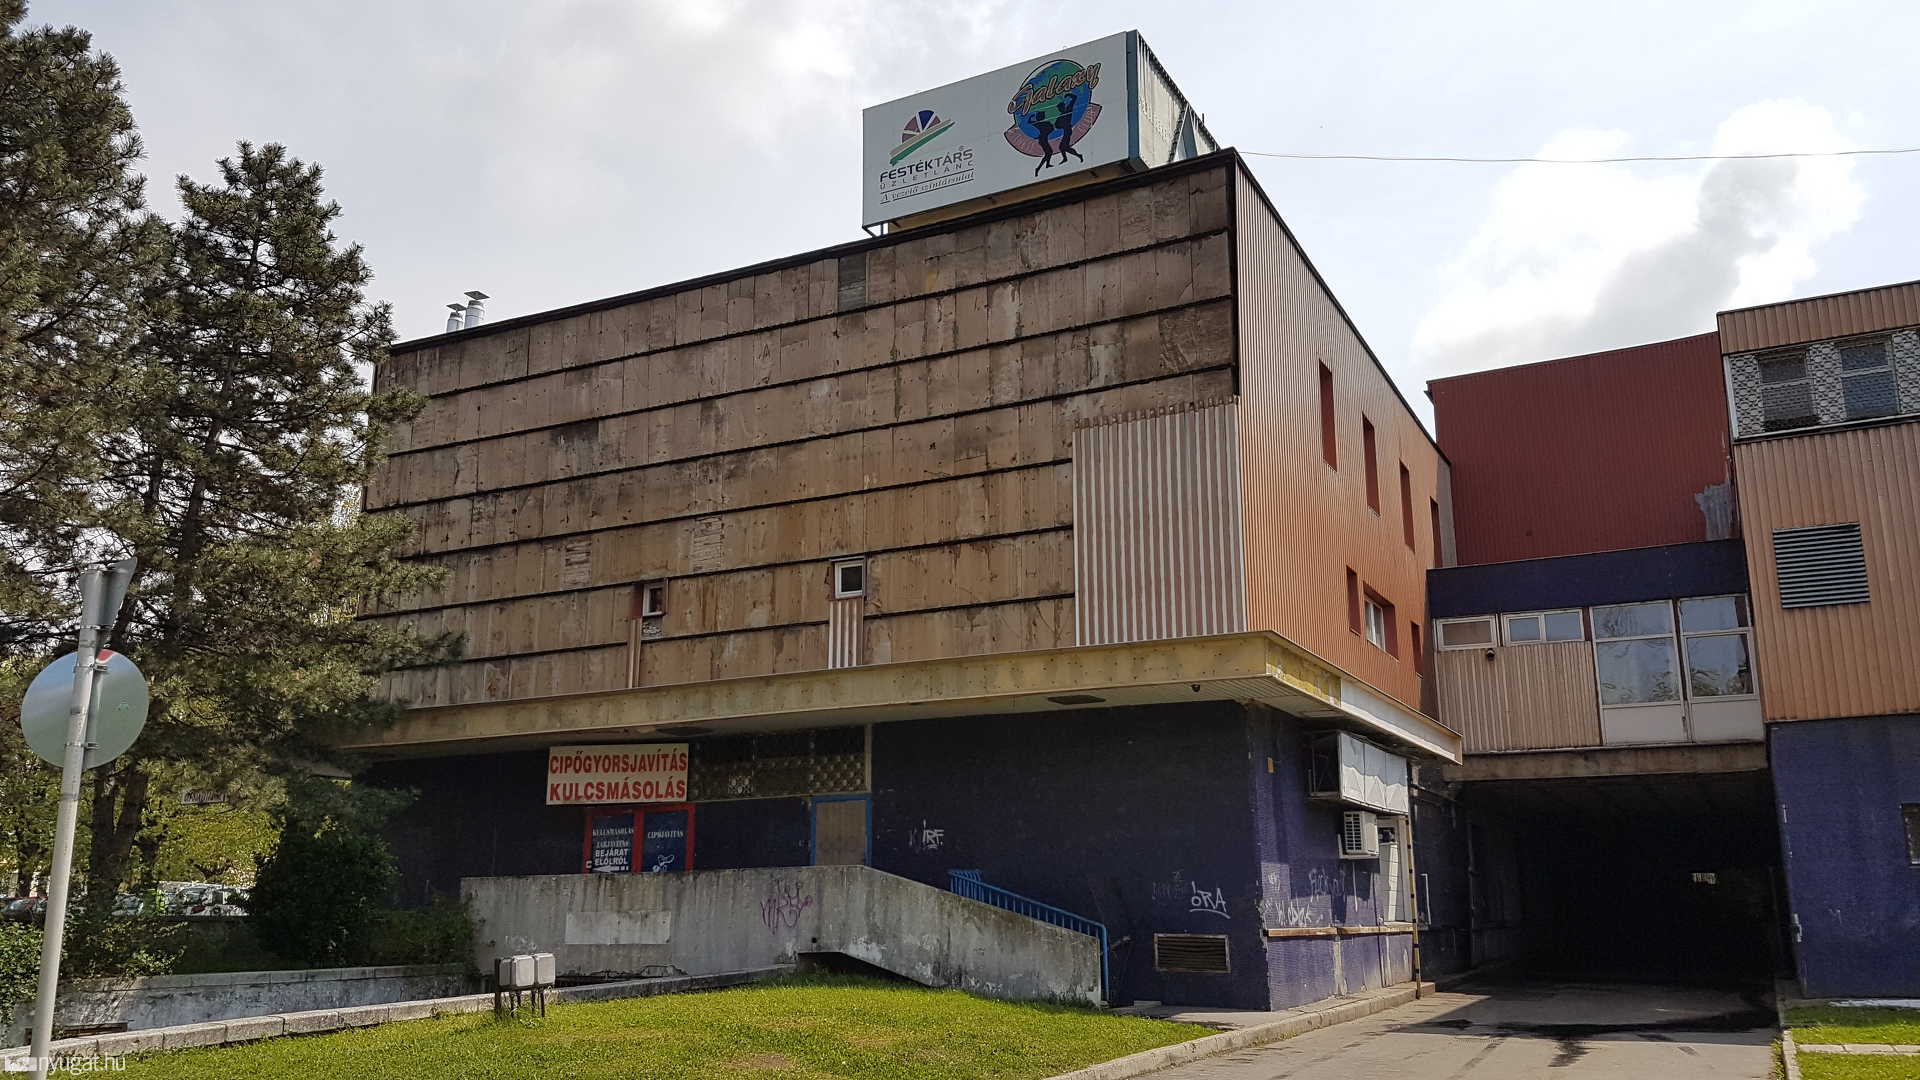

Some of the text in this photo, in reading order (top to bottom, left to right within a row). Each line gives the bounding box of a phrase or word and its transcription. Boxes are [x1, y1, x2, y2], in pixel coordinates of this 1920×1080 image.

[1008, 63, 1101, 115] Galaxy
[549, 748, 687, 774] CIPŐGYORSJAVÍTÁS
[549, 776, 686, 801] KULCSMÁSOLÁS
[595, 848, 628, 857] BEJÁRAT
